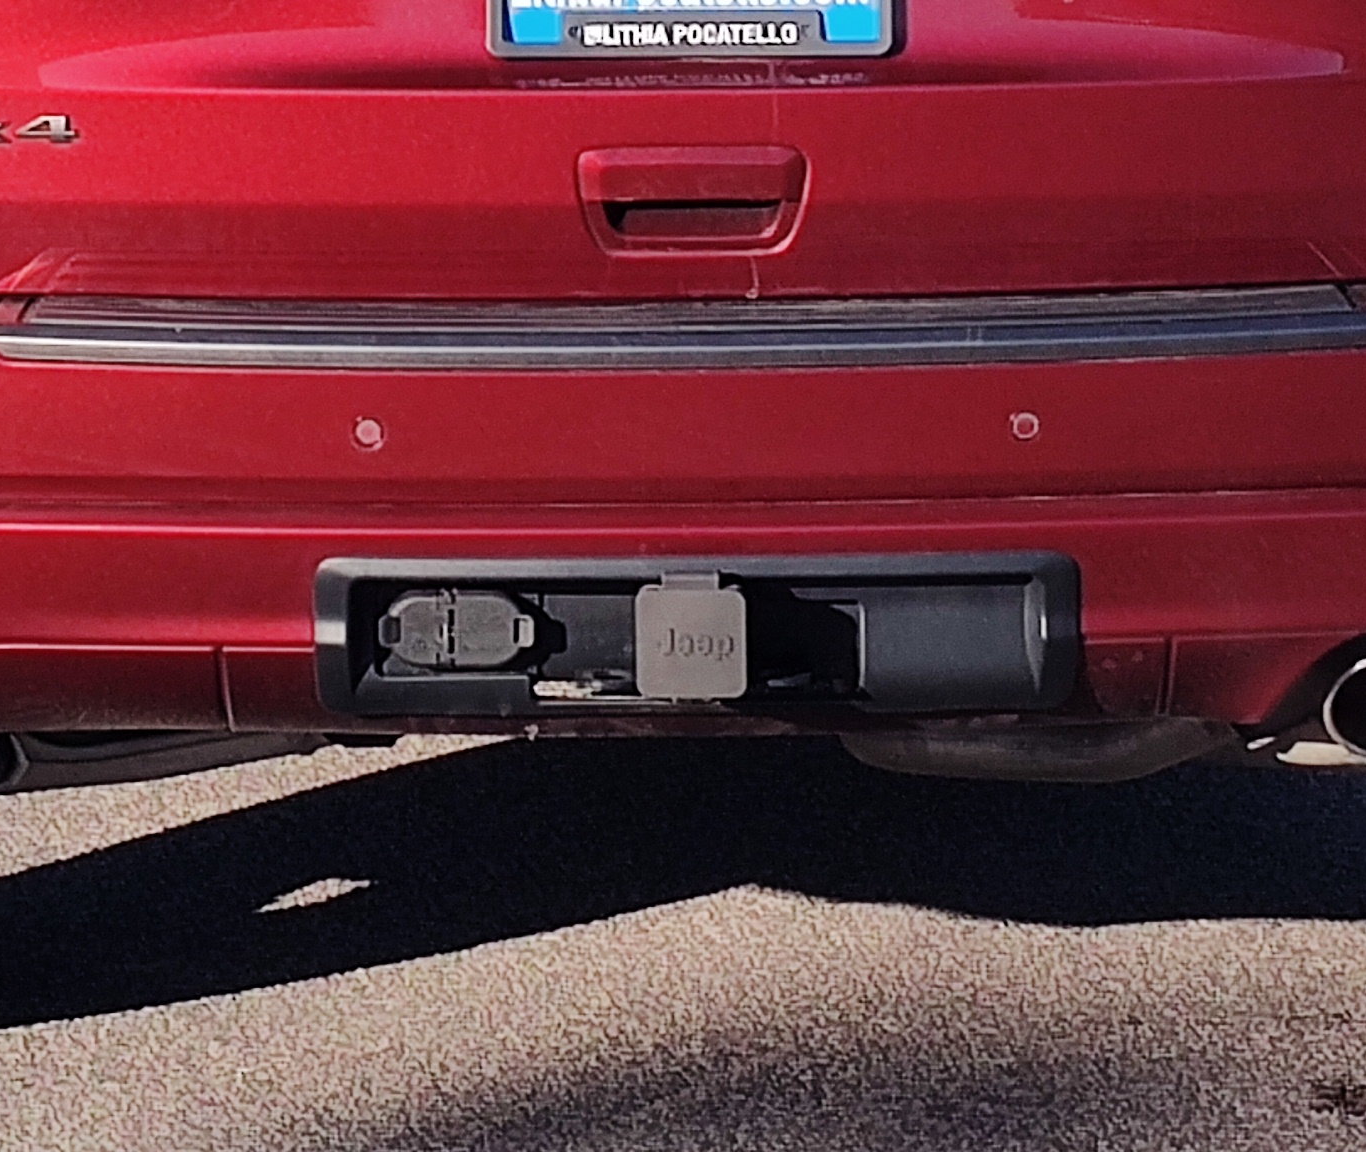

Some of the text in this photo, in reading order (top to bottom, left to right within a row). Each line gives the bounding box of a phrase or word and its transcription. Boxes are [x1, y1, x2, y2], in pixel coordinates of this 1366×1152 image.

[603, 23, 798, 46] LITHIA POCATELLO
[657, 628, 735, 662] Jeep
